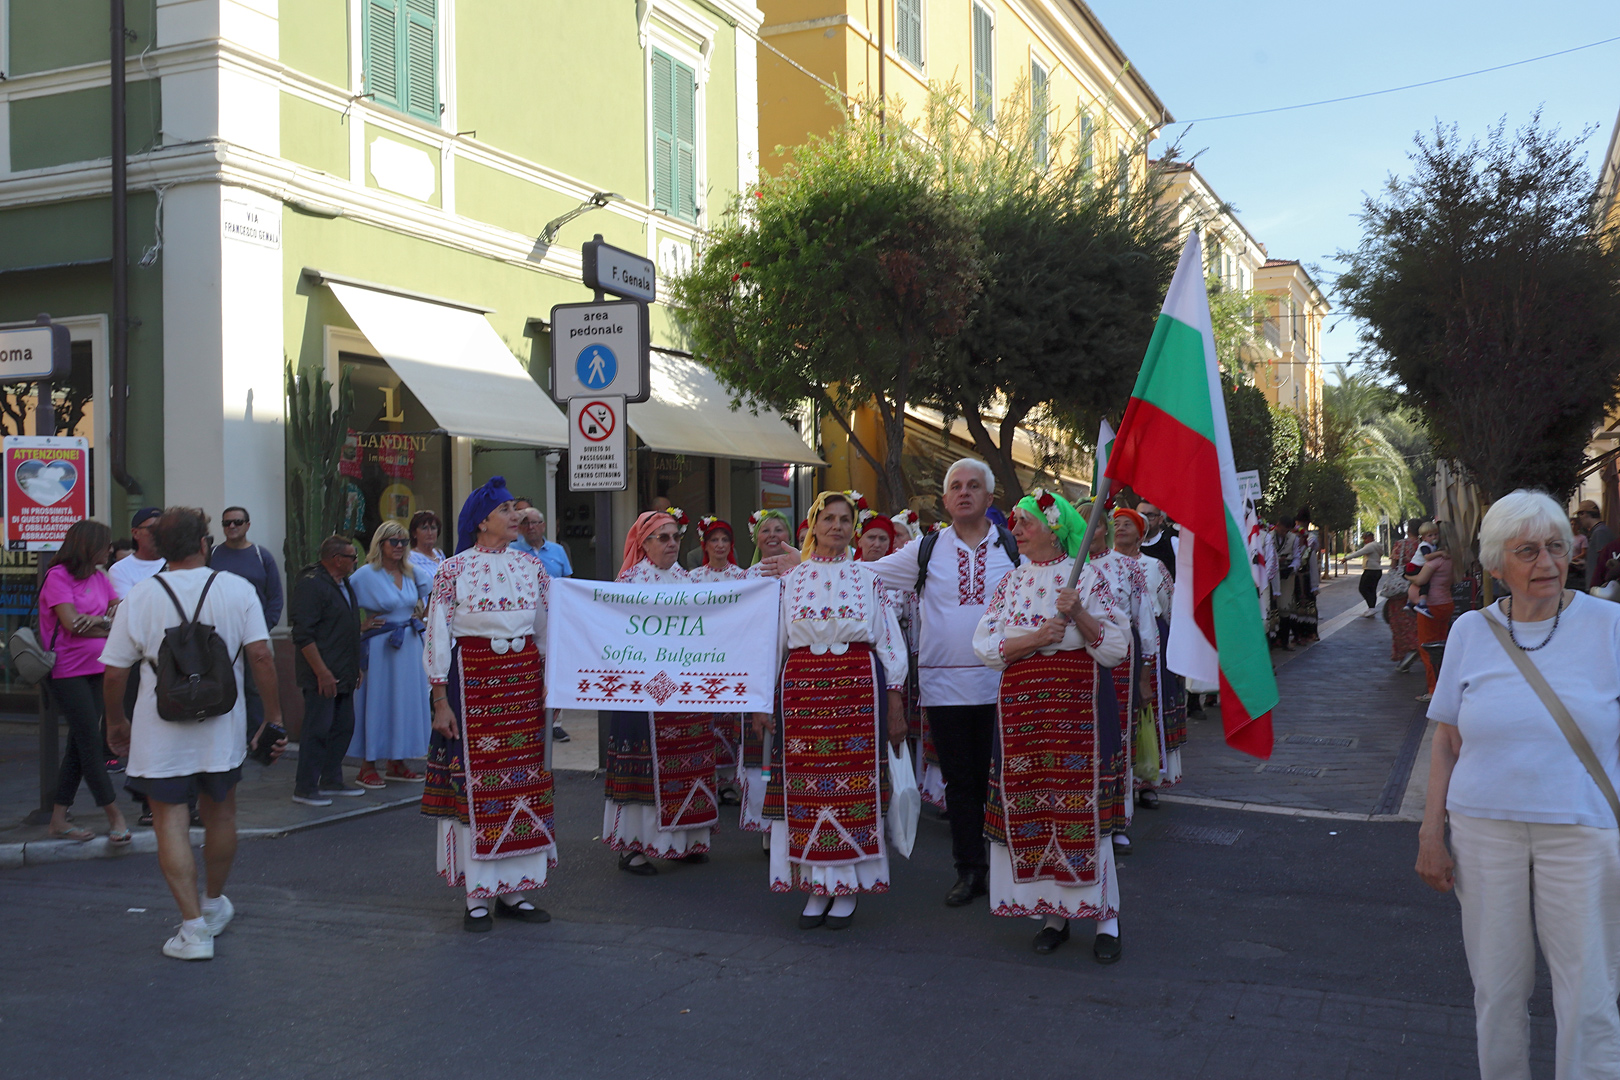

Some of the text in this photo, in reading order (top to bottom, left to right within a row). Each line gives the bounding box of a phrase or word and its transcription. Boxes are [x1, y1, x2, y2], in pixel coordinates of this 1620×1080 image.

[247, 211, 258, 224] VIA
[224, 221, 279, 243] FRANCESCO GENALA
[612, 266, 651, 291] F. Genala
[583, 311, 609, 321] area
[569, 323, 624, 339] pedonale
[0, 348, 33, 362] oma
[378, 386, 405, 423] L
[357, 431, 427, 451] LANDINI
[13, 449, 79, 460] ATTENZIONE!
[583, 445, 604, 453] DIVIETO
[21, 505, 73, 515] IN PROSSIMITÀ
[21, 515, 49, 524] QUESTO
[50, 515, 83, 524] SEGNALE
[20, 532, 67, 540] ABBRACCIAR
[0, 551, 38, 566] NTE
[0, 594, 17, 606] AVI
[593, 588, 742, 606] Female Folk Choir
[625, 614, 706, 637] SOFIA
[601, 645, 726, 667] Sofia, Bulgaria
